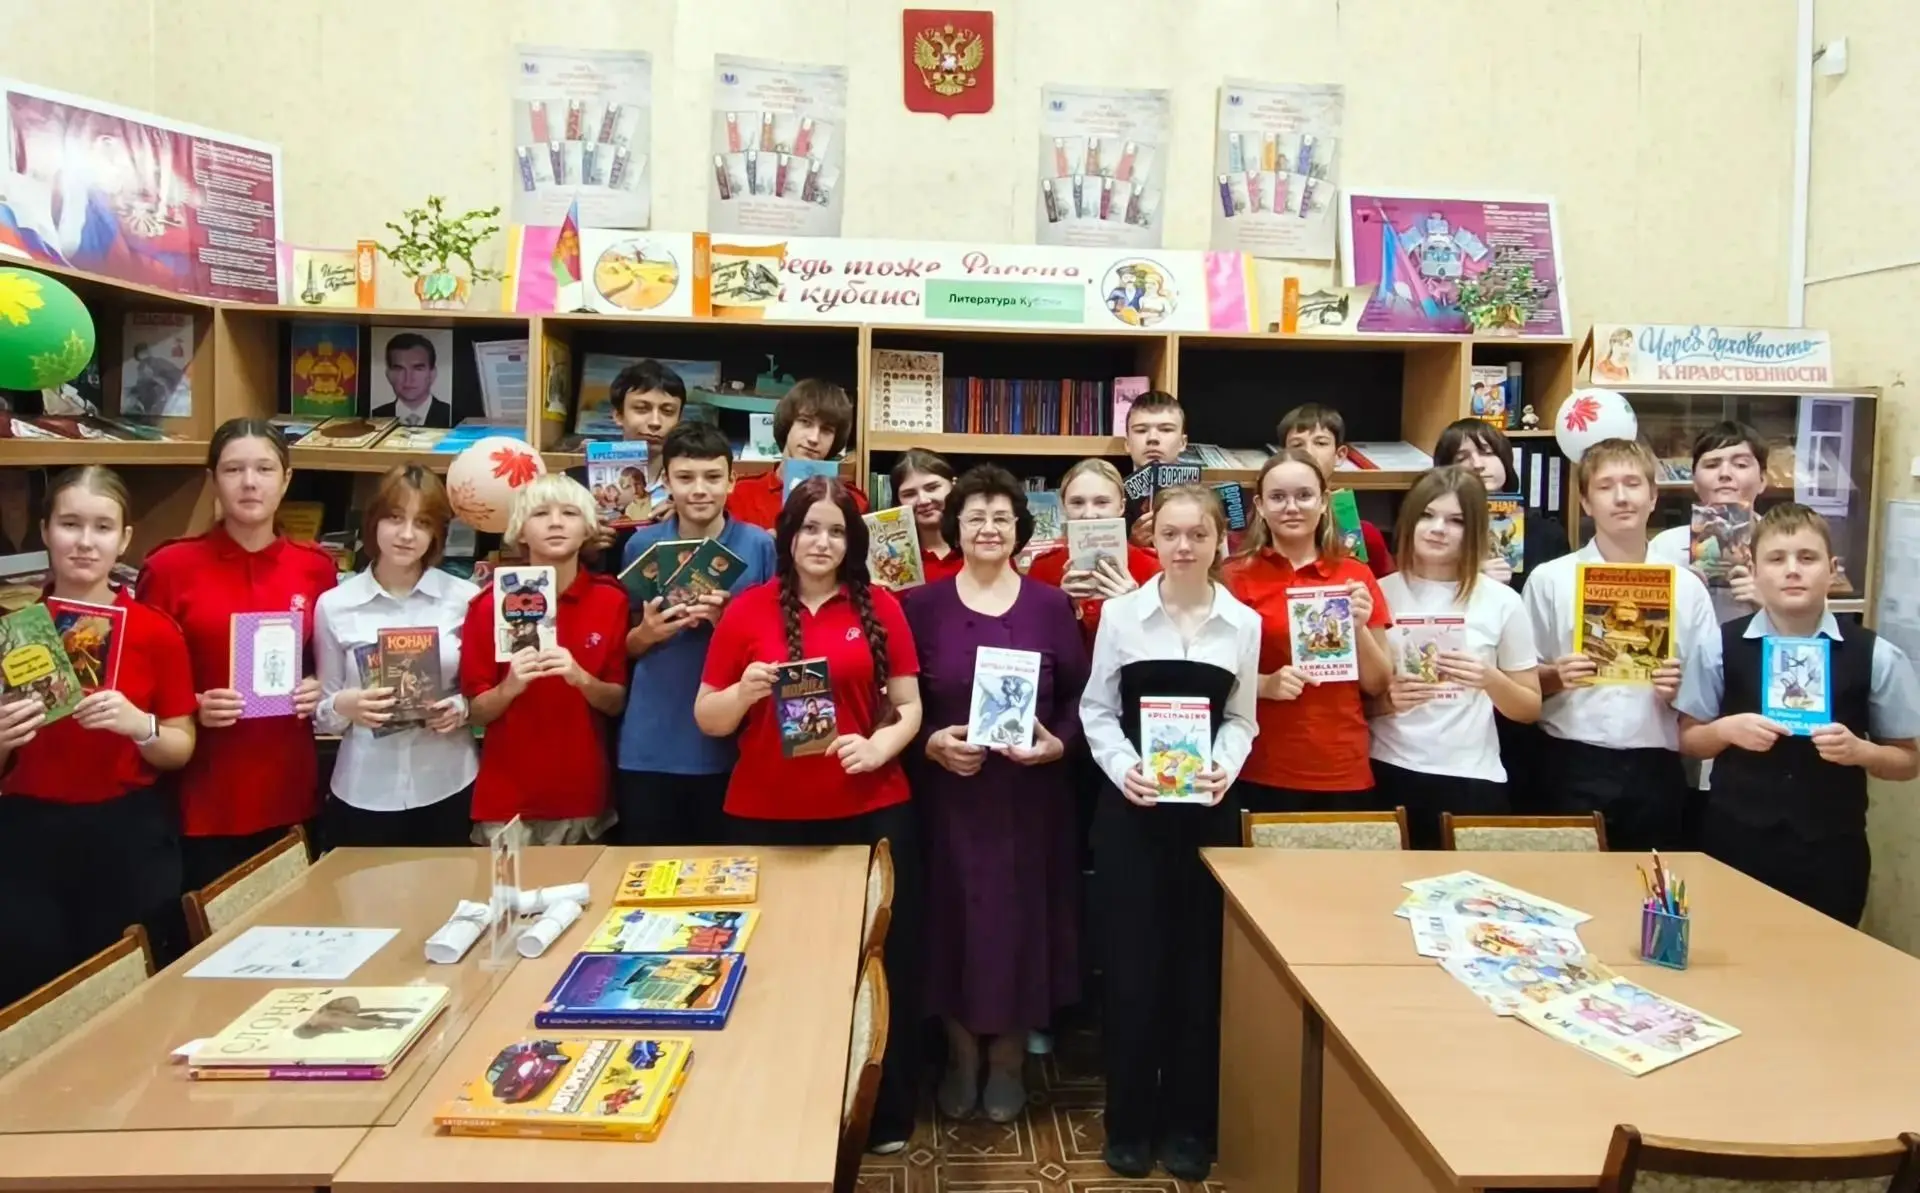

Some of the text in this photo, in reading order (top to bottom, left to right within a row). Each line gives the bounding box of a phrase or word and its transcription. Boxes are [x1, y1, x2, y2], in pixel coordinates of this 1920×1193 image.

[800, 280, 921, 313] кубанс
[949, 293, 1017, 307] Литература
[1638, 326, 1826, 364] Через духовность
[1657, 364, 1828, 383] К НРАВСТВЕННОСТИ
[1584, 586, 1669, 601] ЧУДЕСА СВЕТА
[387, 634, 432, 650] КОНАН
[220, 992, 315, 1055] СЛОНЫ
